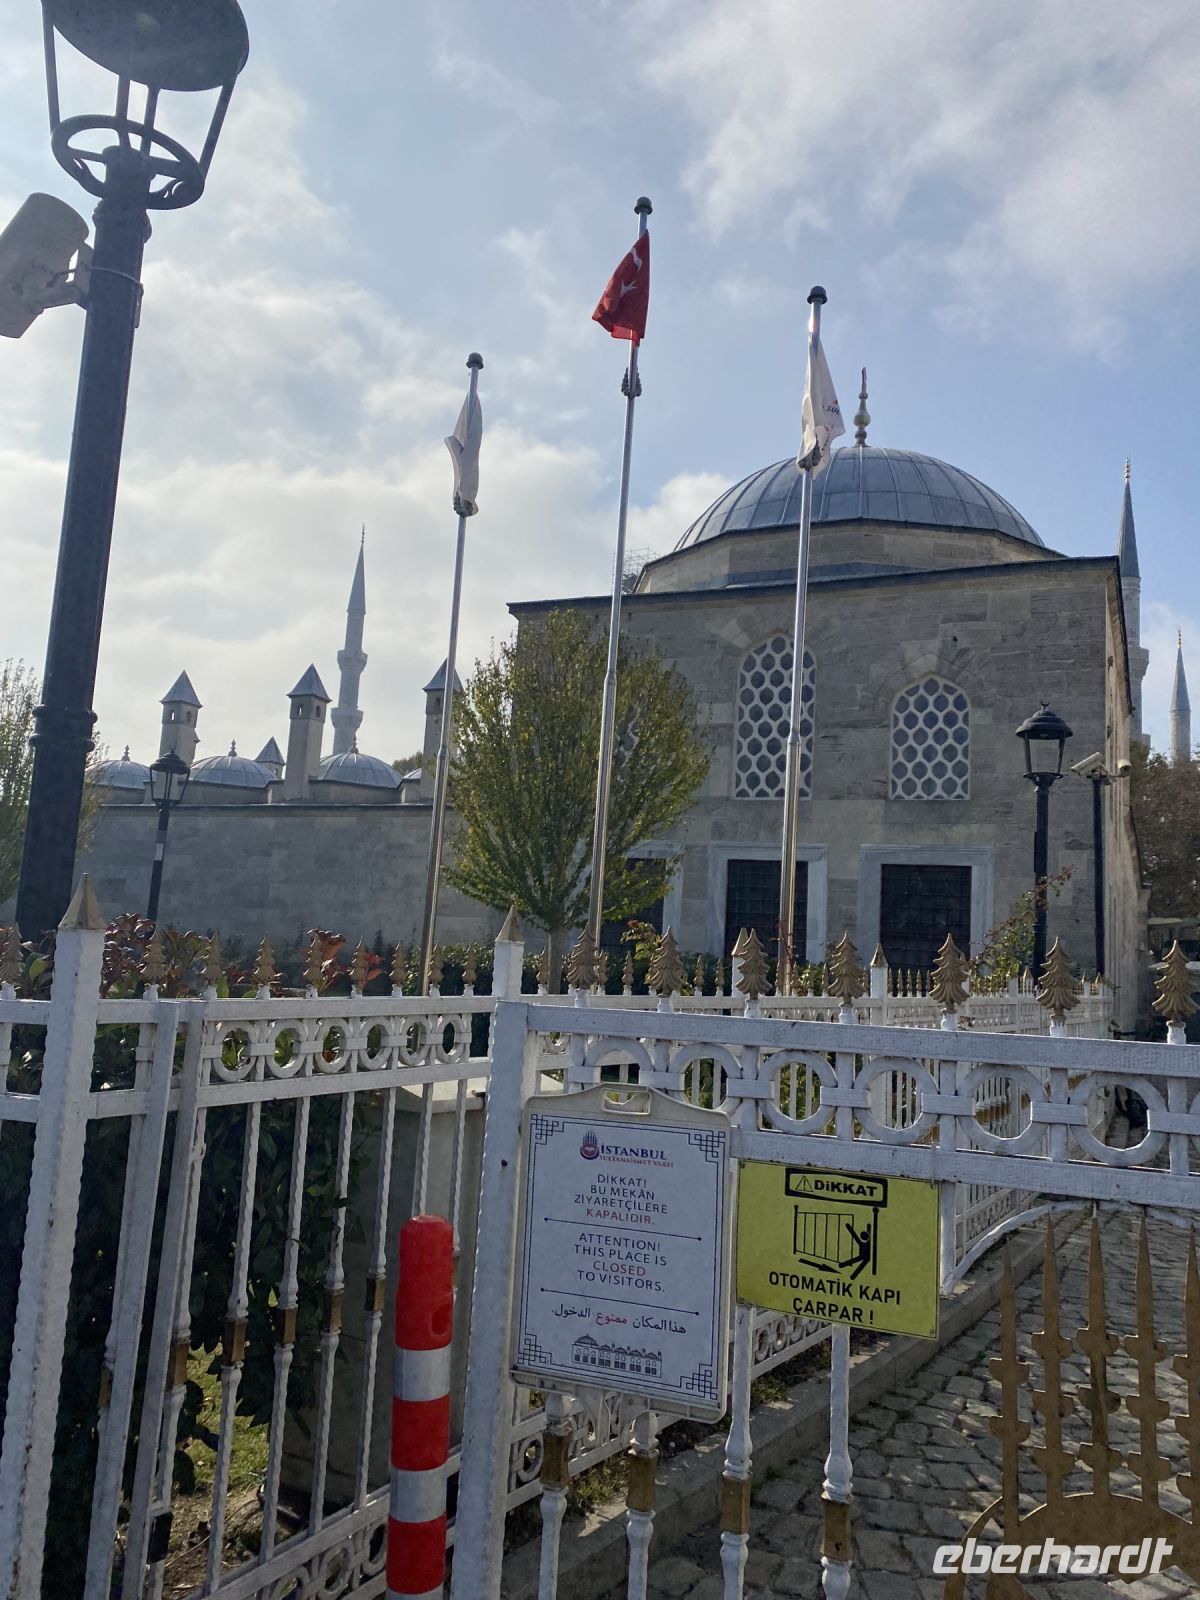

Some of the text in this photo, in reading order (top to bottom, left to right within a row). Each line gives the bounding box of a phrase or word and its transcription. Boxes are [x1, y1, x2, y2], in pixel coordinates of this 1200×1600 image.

[601, 1143, 667, 1160] İSTANBUL
[597, 1173, 647, 1188] DİKKAT!
[590, 1184, 655, 1201] BU MEKÂN
[574, 1194, 668, 1214] ZİYARETÇİLERE
[586, 1208, 655, 1225] KAPALIDIR.
[579, 1232, 660, 1252] ATTENTION!
[574, 1244, 667, 1266] THIS PLACE IS
[593, 1260, 646, 1276] CLOSED
[577, 1269, 665, 1292] TO VISITORS.
[769, 1271, 900, 1305] OTOMATİK KAPI
[595, 1311, 627, 1325] ممنوع
[793, 1297, 864, 1323] ÇARPAR
[632, 1315, 667, 1331] المكان
[669, 1321, 686, 1333] هذا
